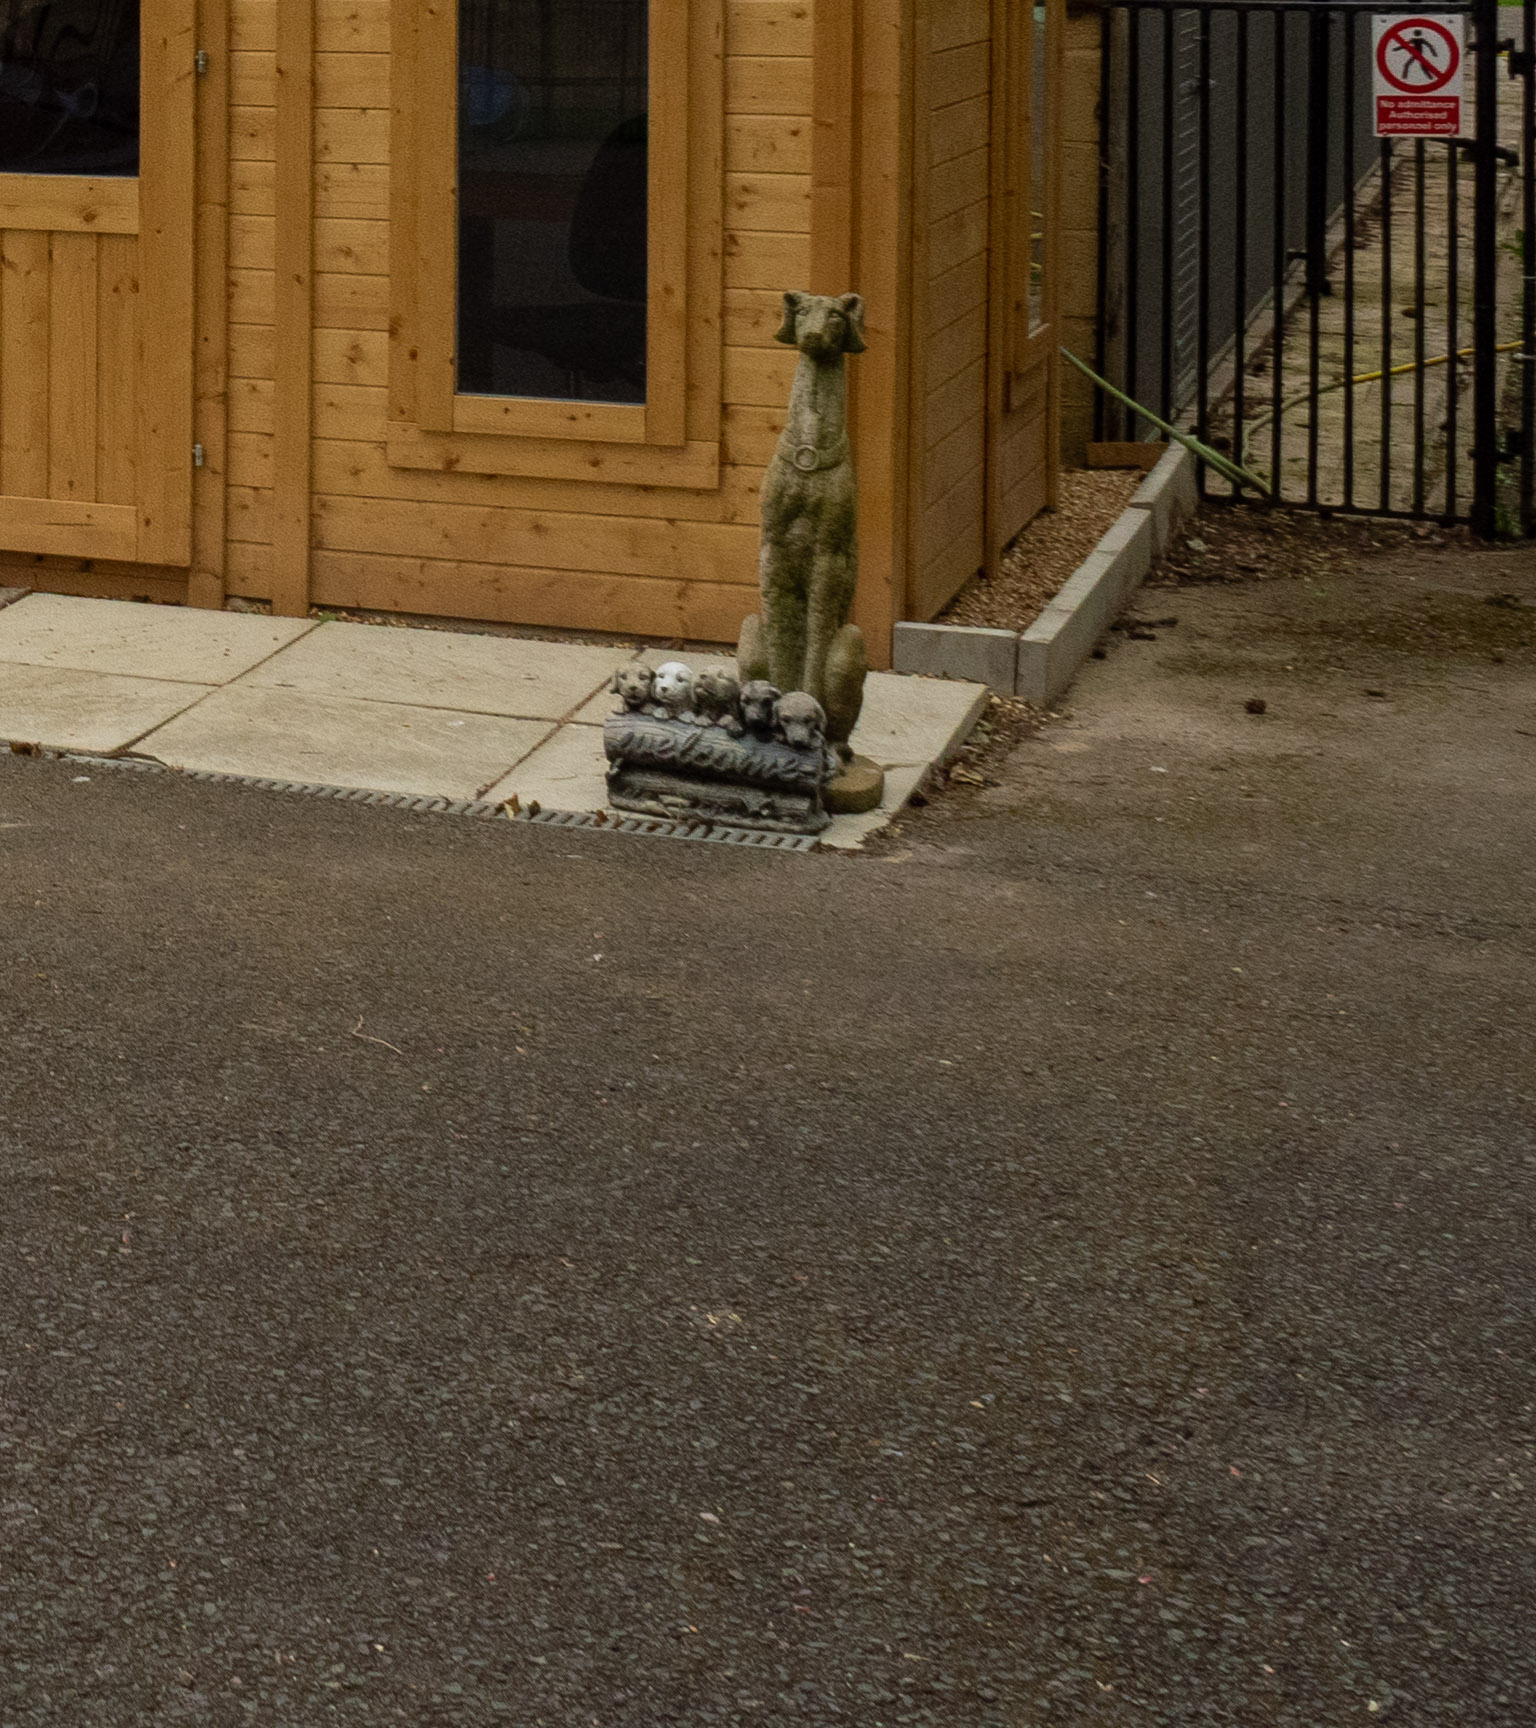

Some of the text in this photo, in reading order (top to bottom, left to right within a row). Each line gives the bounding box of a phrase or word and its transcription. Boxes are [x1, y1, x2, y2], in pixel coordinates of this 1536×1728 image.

[1379, 99, 1456, 109] No admittance
[1389, 110, 1448, 119] Authorised
[1378, 120, 1457, 132] personnel only
